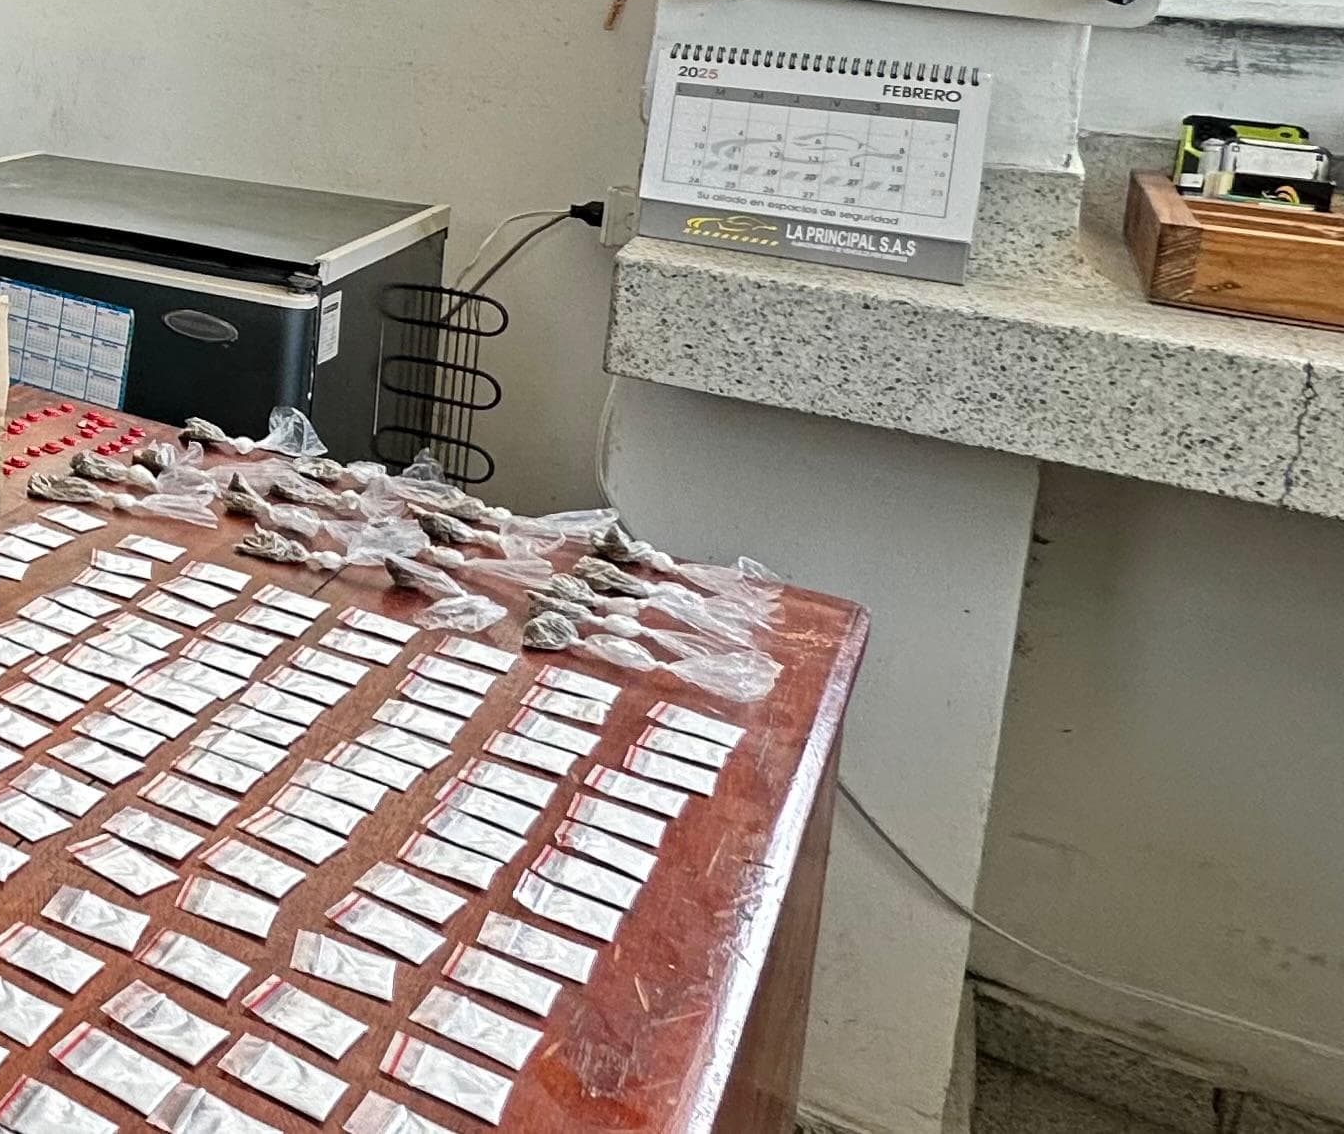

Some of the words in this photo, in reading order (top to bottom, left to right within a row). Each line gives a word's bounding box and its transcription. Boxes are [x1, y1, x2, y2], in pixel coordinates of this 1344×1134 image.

[678, 66, 719, 80] 2025
[883, 84, 962, 102] FEBRERO
[697, 191, 710, 200] Su
[713, 192, 747, 205] aliado
[768, 201, 817, 215] espacios
[821, 208, 836, 217] de
[839, 210, 899, 225] seguridad
[786, 223, 804, 240] LA
[806, 225, 876, 251] PRINCIPAL
